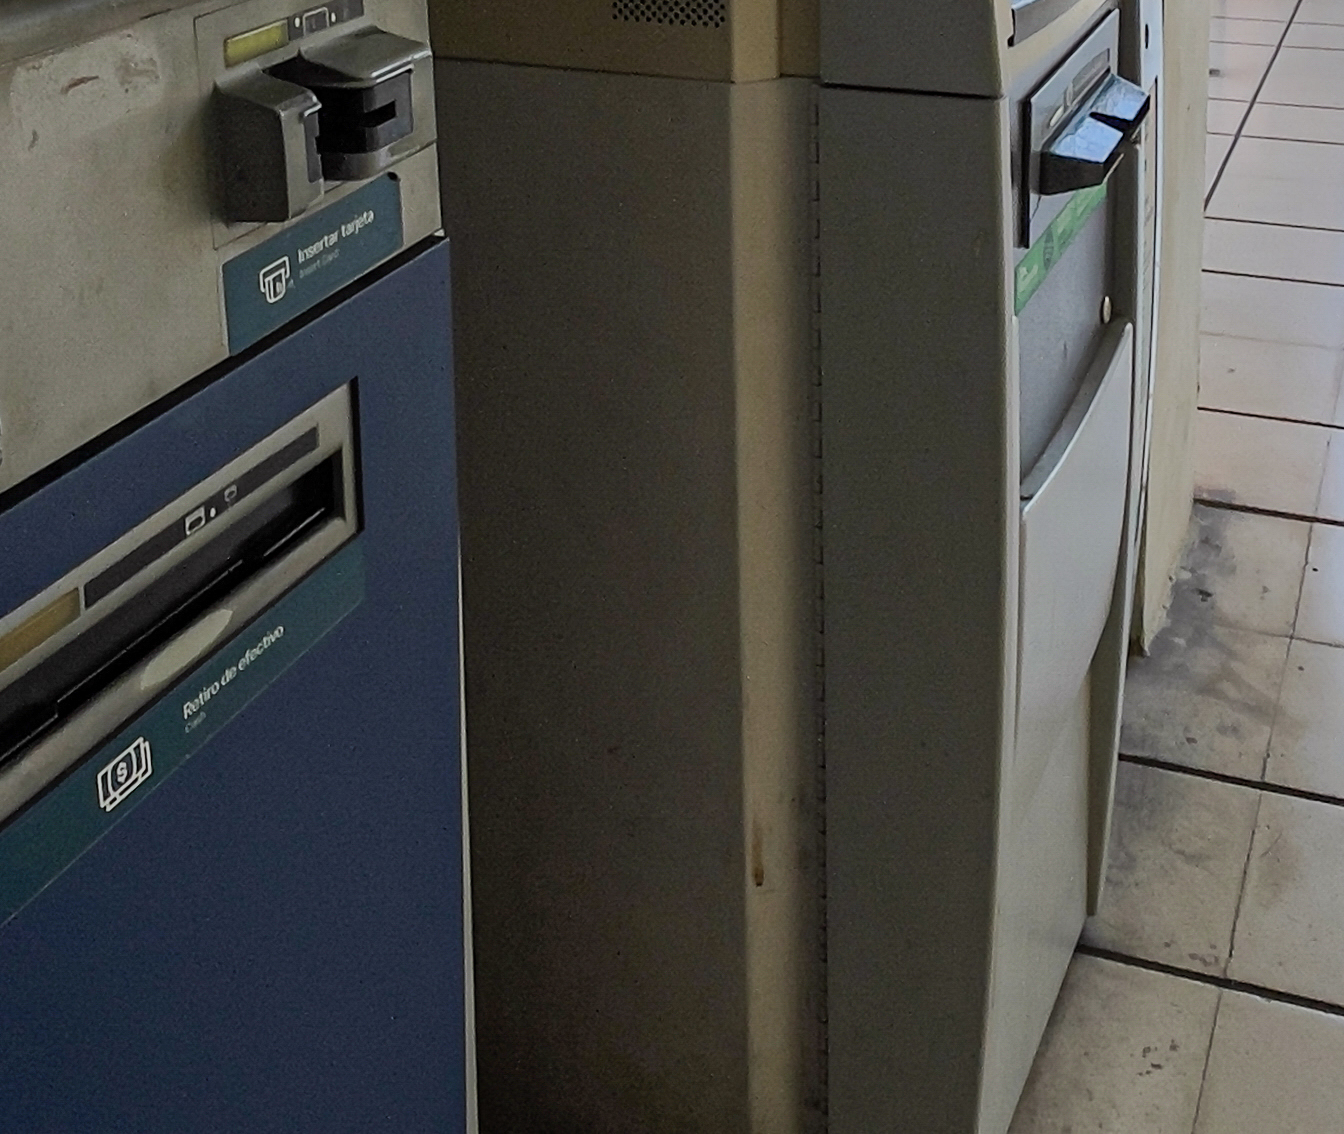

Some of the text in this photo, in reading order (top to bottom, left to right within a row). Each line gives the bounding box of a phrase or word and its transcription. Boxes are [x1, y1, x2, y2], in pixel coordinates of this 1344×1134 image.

[298, 210, 374, 263] Insertar tarjeta
[183, 626, 284, 720] Retiro de efectivo
